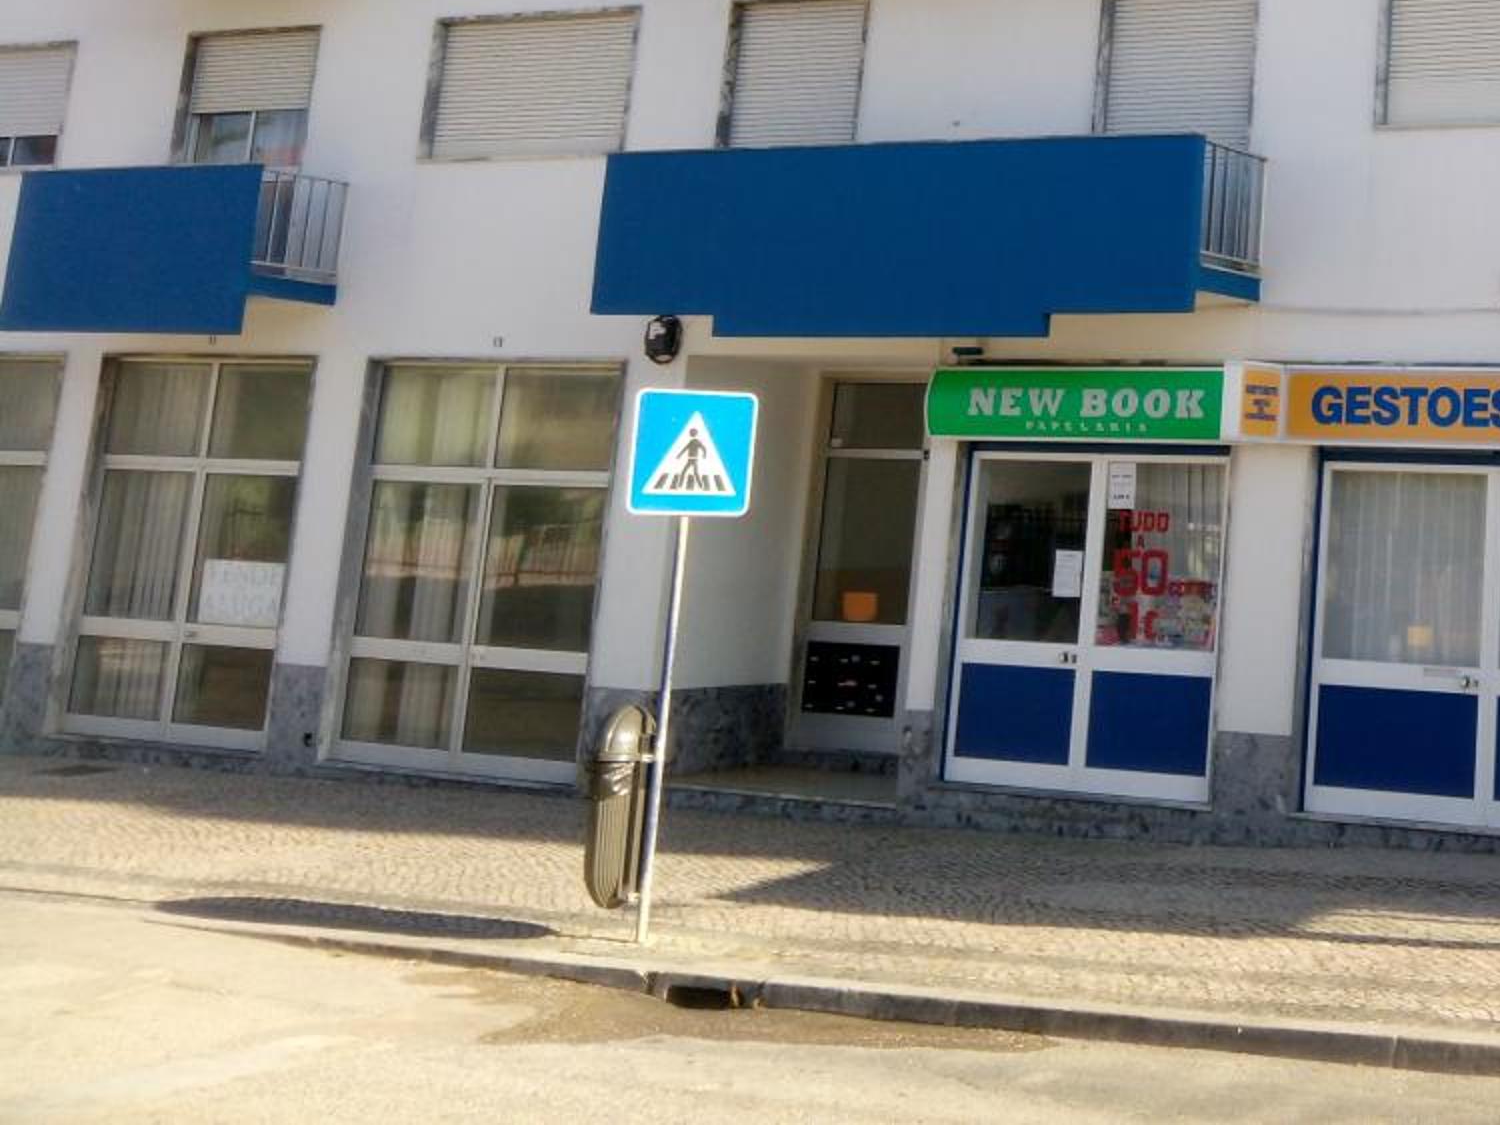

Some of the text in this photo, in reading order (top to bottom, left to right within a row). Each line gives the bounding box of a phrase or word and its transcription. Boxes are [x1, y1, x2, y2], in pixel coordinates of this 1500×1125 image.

[967, 387, 1205, 419] NEW BOOK
[1119, 510, 1170, 533] TUDO
[1112, 549, 1169, 597] 50
